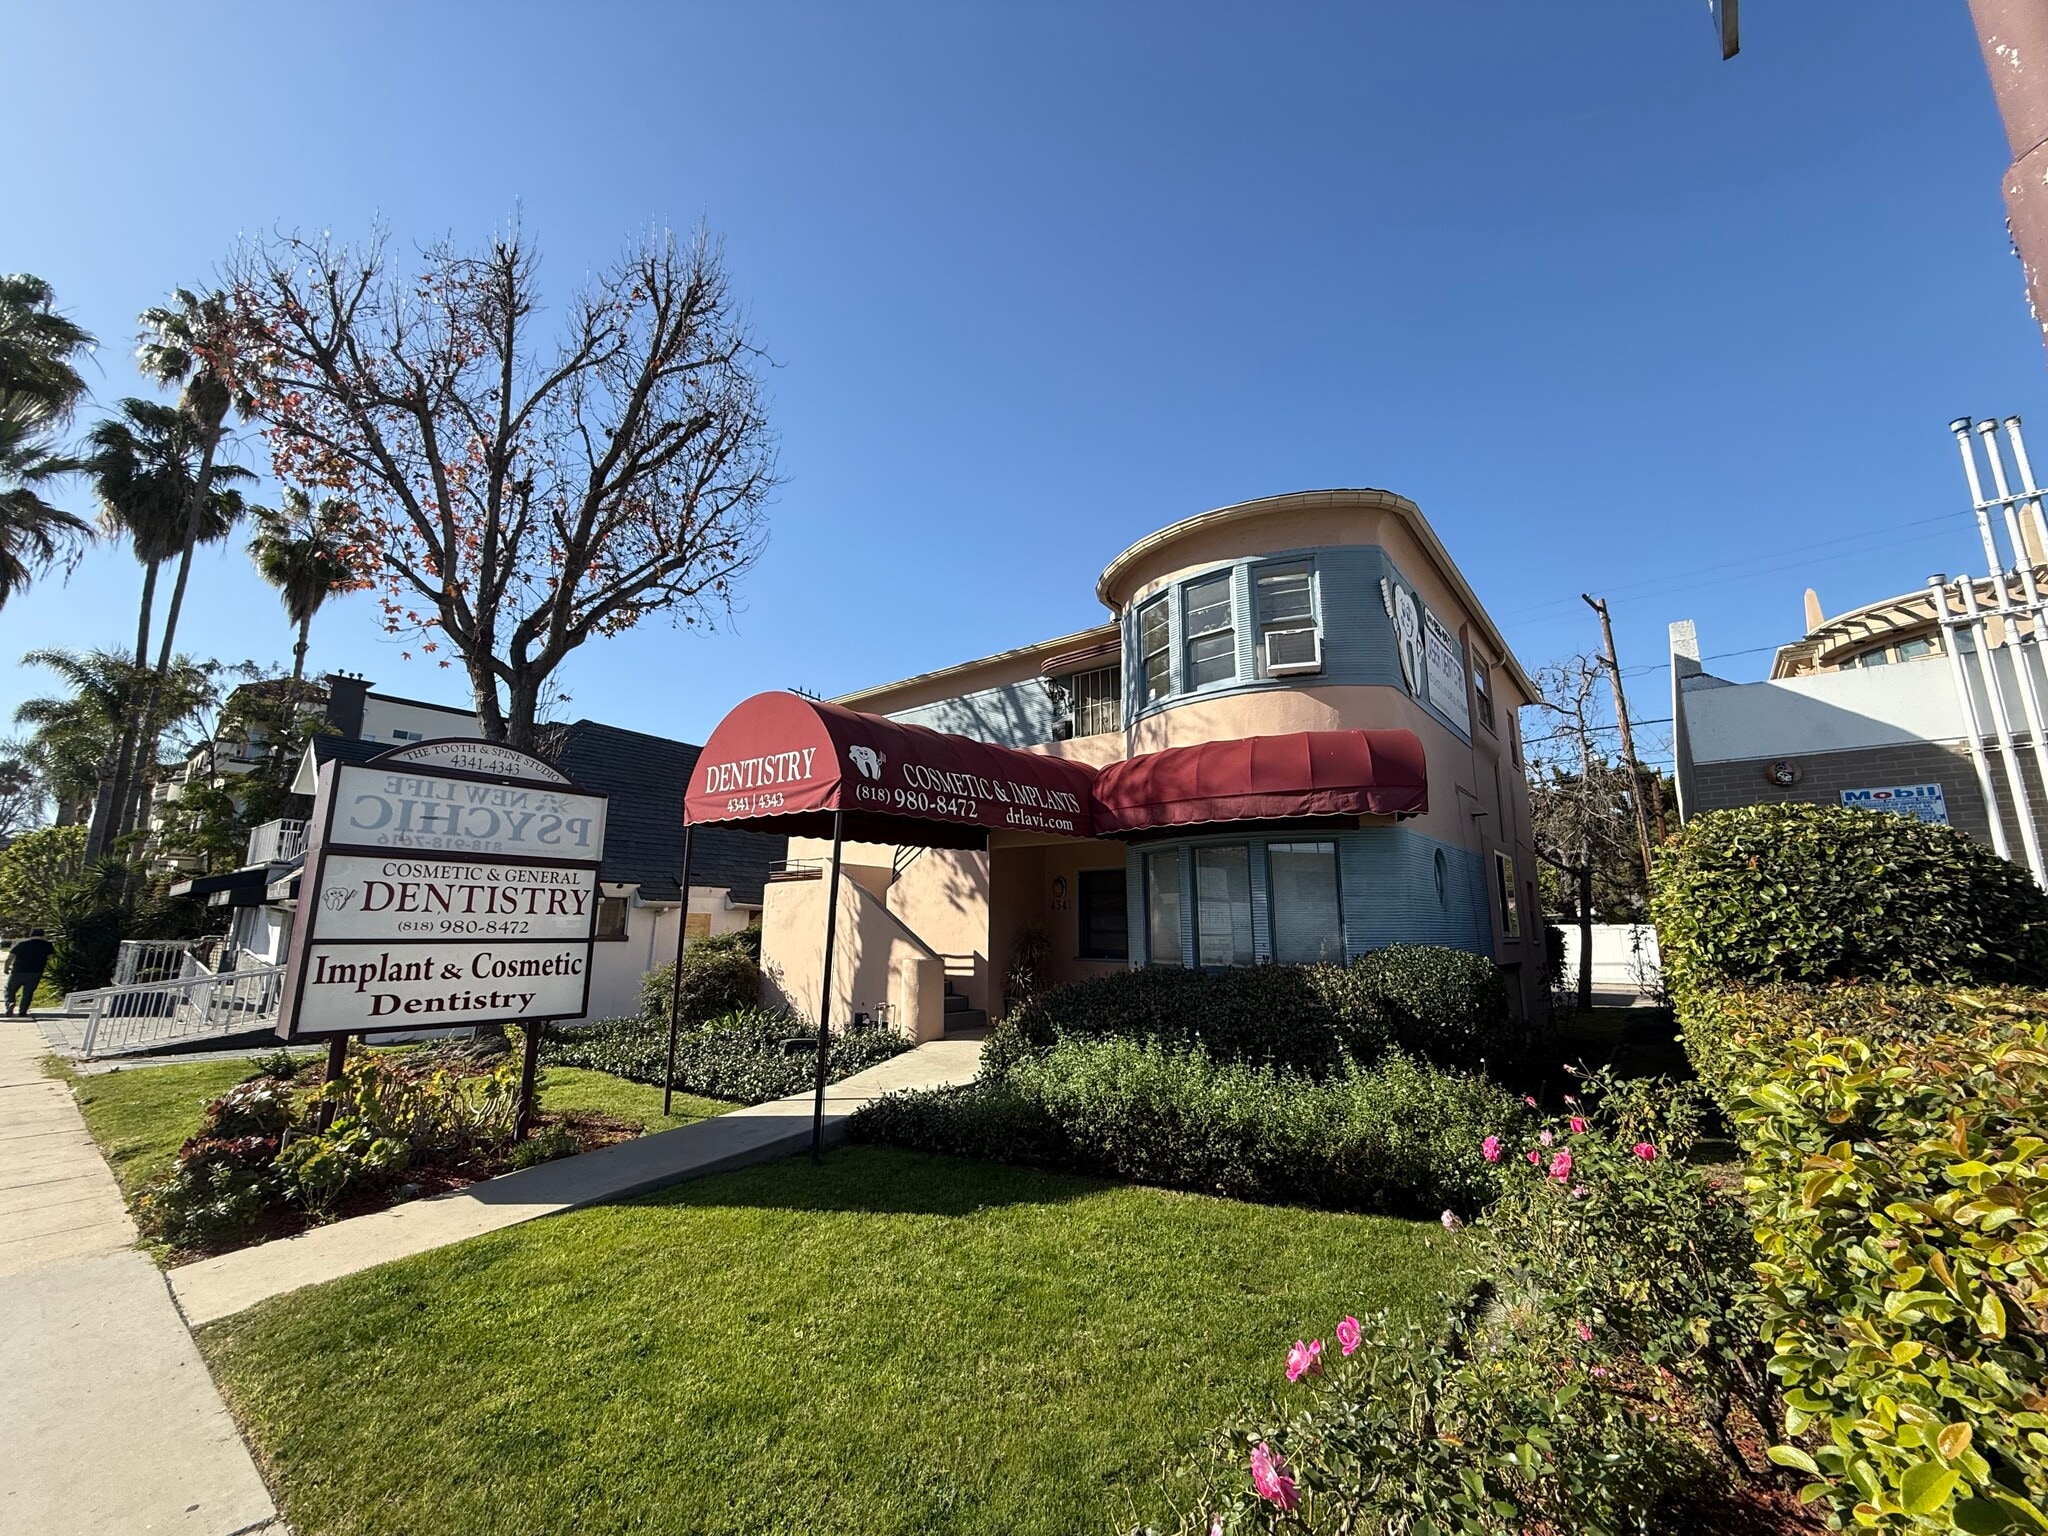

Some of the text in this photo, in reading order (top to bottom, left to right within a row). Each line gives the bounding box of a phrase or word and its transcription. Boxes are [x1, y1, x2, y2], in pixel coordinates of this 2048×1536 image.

[404, 744, 560, 782] THE TOOTH & SPINE STUDIO
[451, 754, 520, 775] 4341-4343
[705, 747, 817, 794] DENTISTRY
[727, 797, 749, 812] 4341
[758, 792, 784, 809] 4343
[856, 783, 978, 819] (818) 980-8472
[903, 763, 1081, 814] COSMETIC & IMPLANTS
[1844, 786, 1937, 801] Mobil
[1006, 807, 1074, 831] drlavi.com
[383, 862, 581, 885] COSMETIC & GENERAL
[360, 880, 591, 916] DENTISTRY
[398, 920, 529, 934] (818) 980-8472
[312, 952, 582, 993] Implant & Cosmetic
[367, 990, 536, 1017] Dentistry
